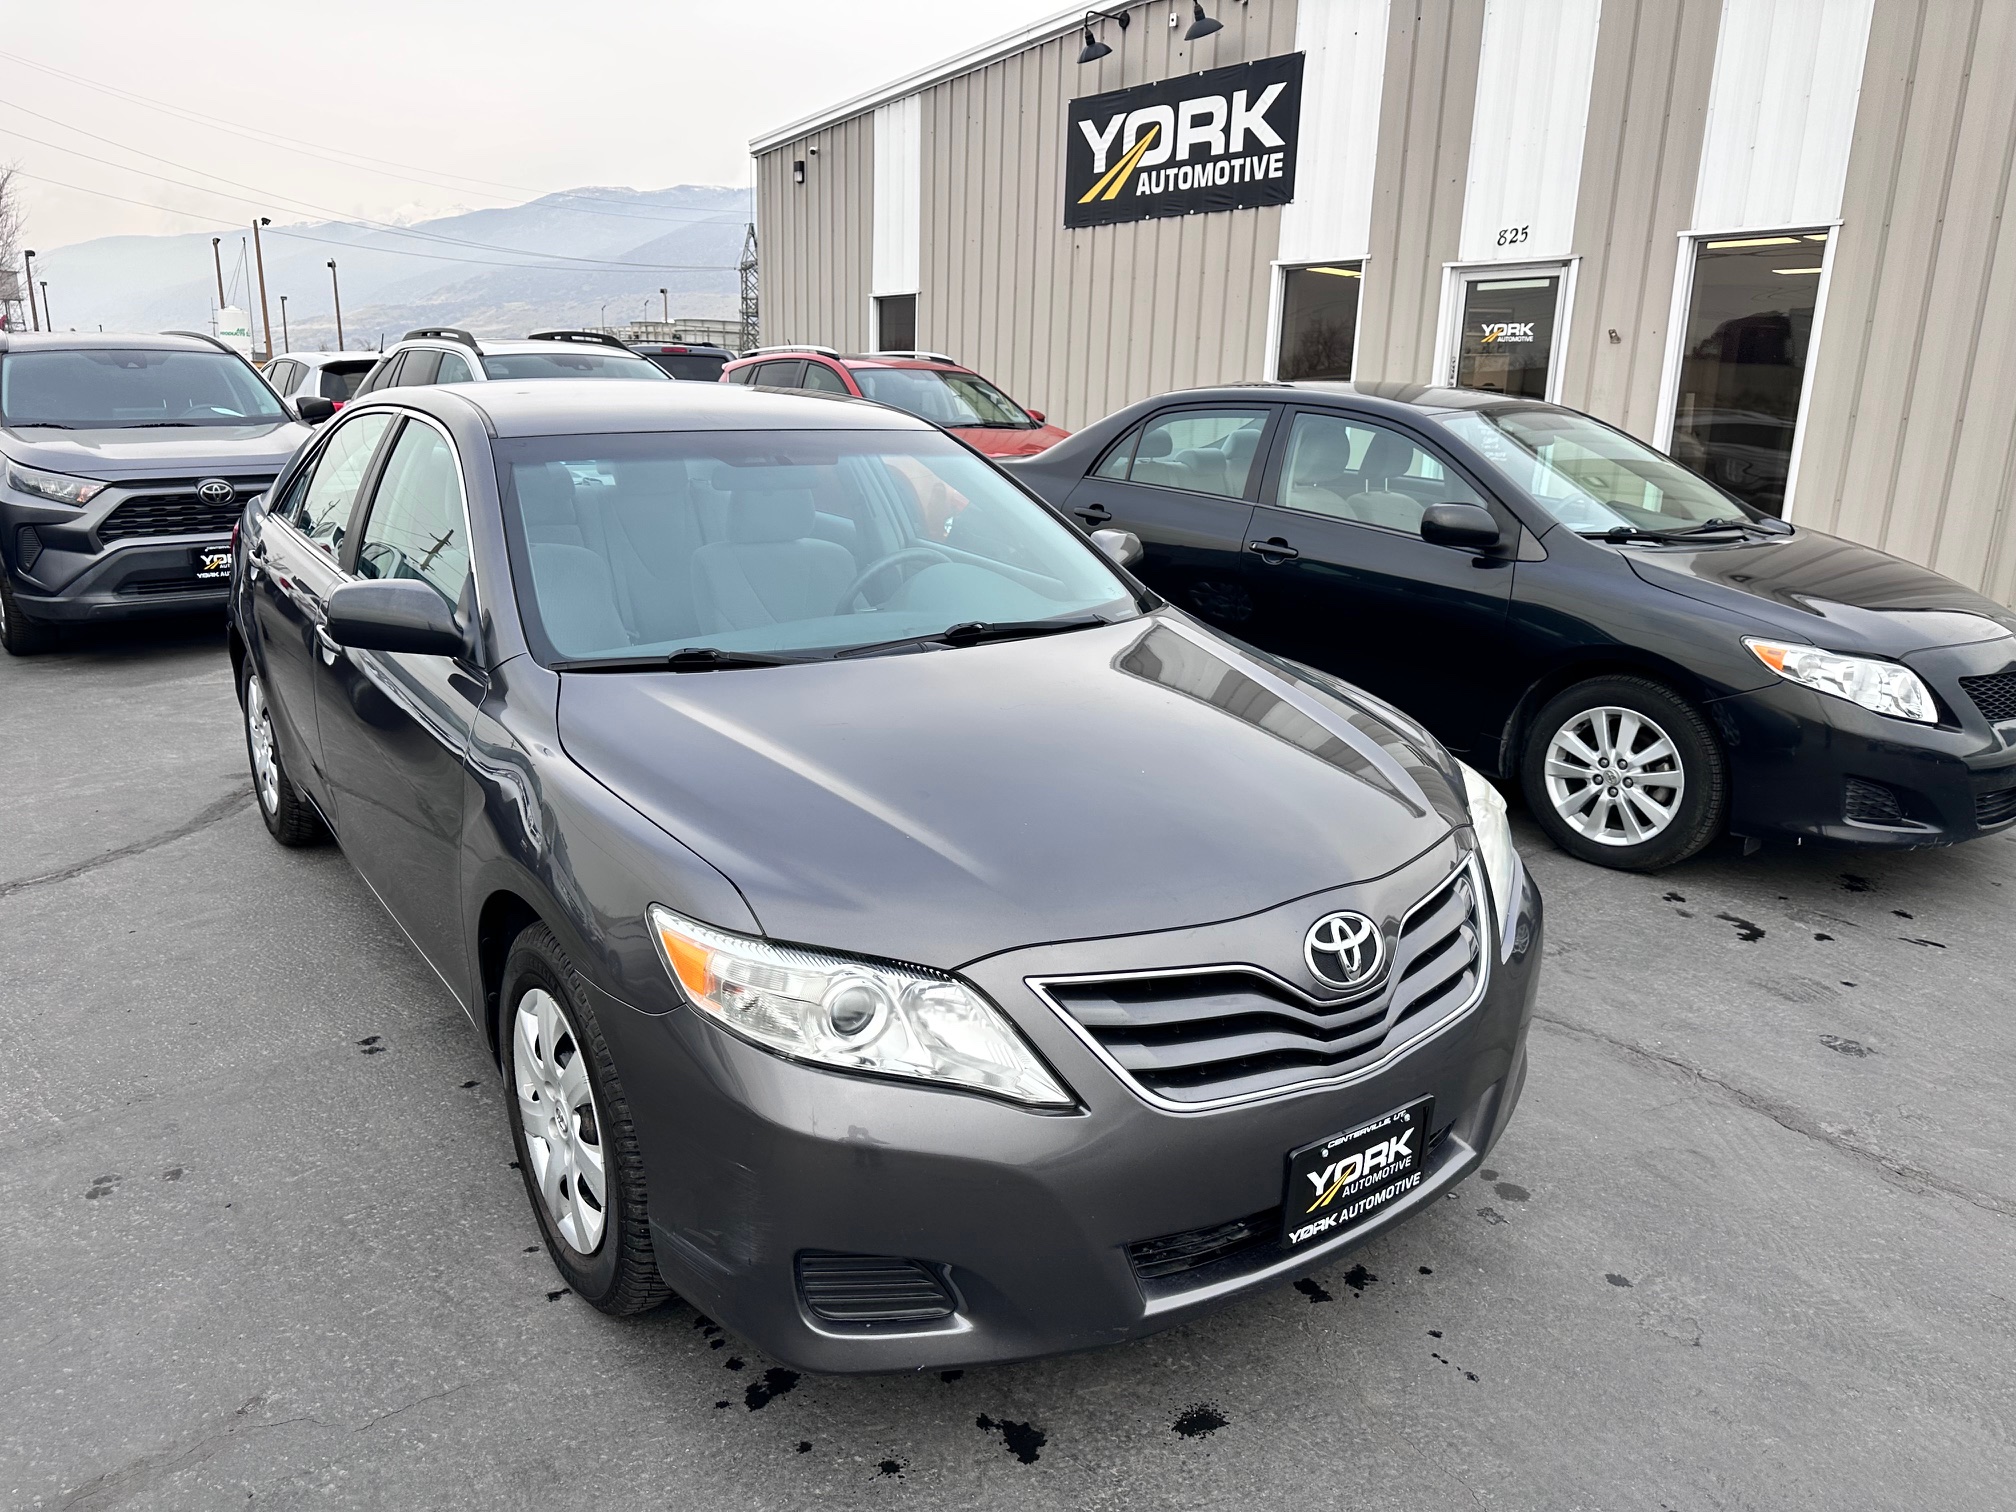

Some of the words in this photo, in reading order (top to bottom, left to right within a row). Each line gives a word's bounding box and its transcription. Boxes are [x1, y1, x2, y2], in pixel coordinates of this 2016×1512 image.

[1078, 82, 1288, 173] YORK
[1135, 152, 1284, 196] AUTOMOTIVE
[1497, 225, 1529, 246] 825
[1481, 322, 1535, 336] YORK
[1306, 1127, 1415, 1197] YORK
[1342, 1155, 1412, 1198] AUTOMOTIVE
[1288, 1212, 1338, 1244] YORK
[1338, 1171, 1422, 1223] AUTOMOTIVE
